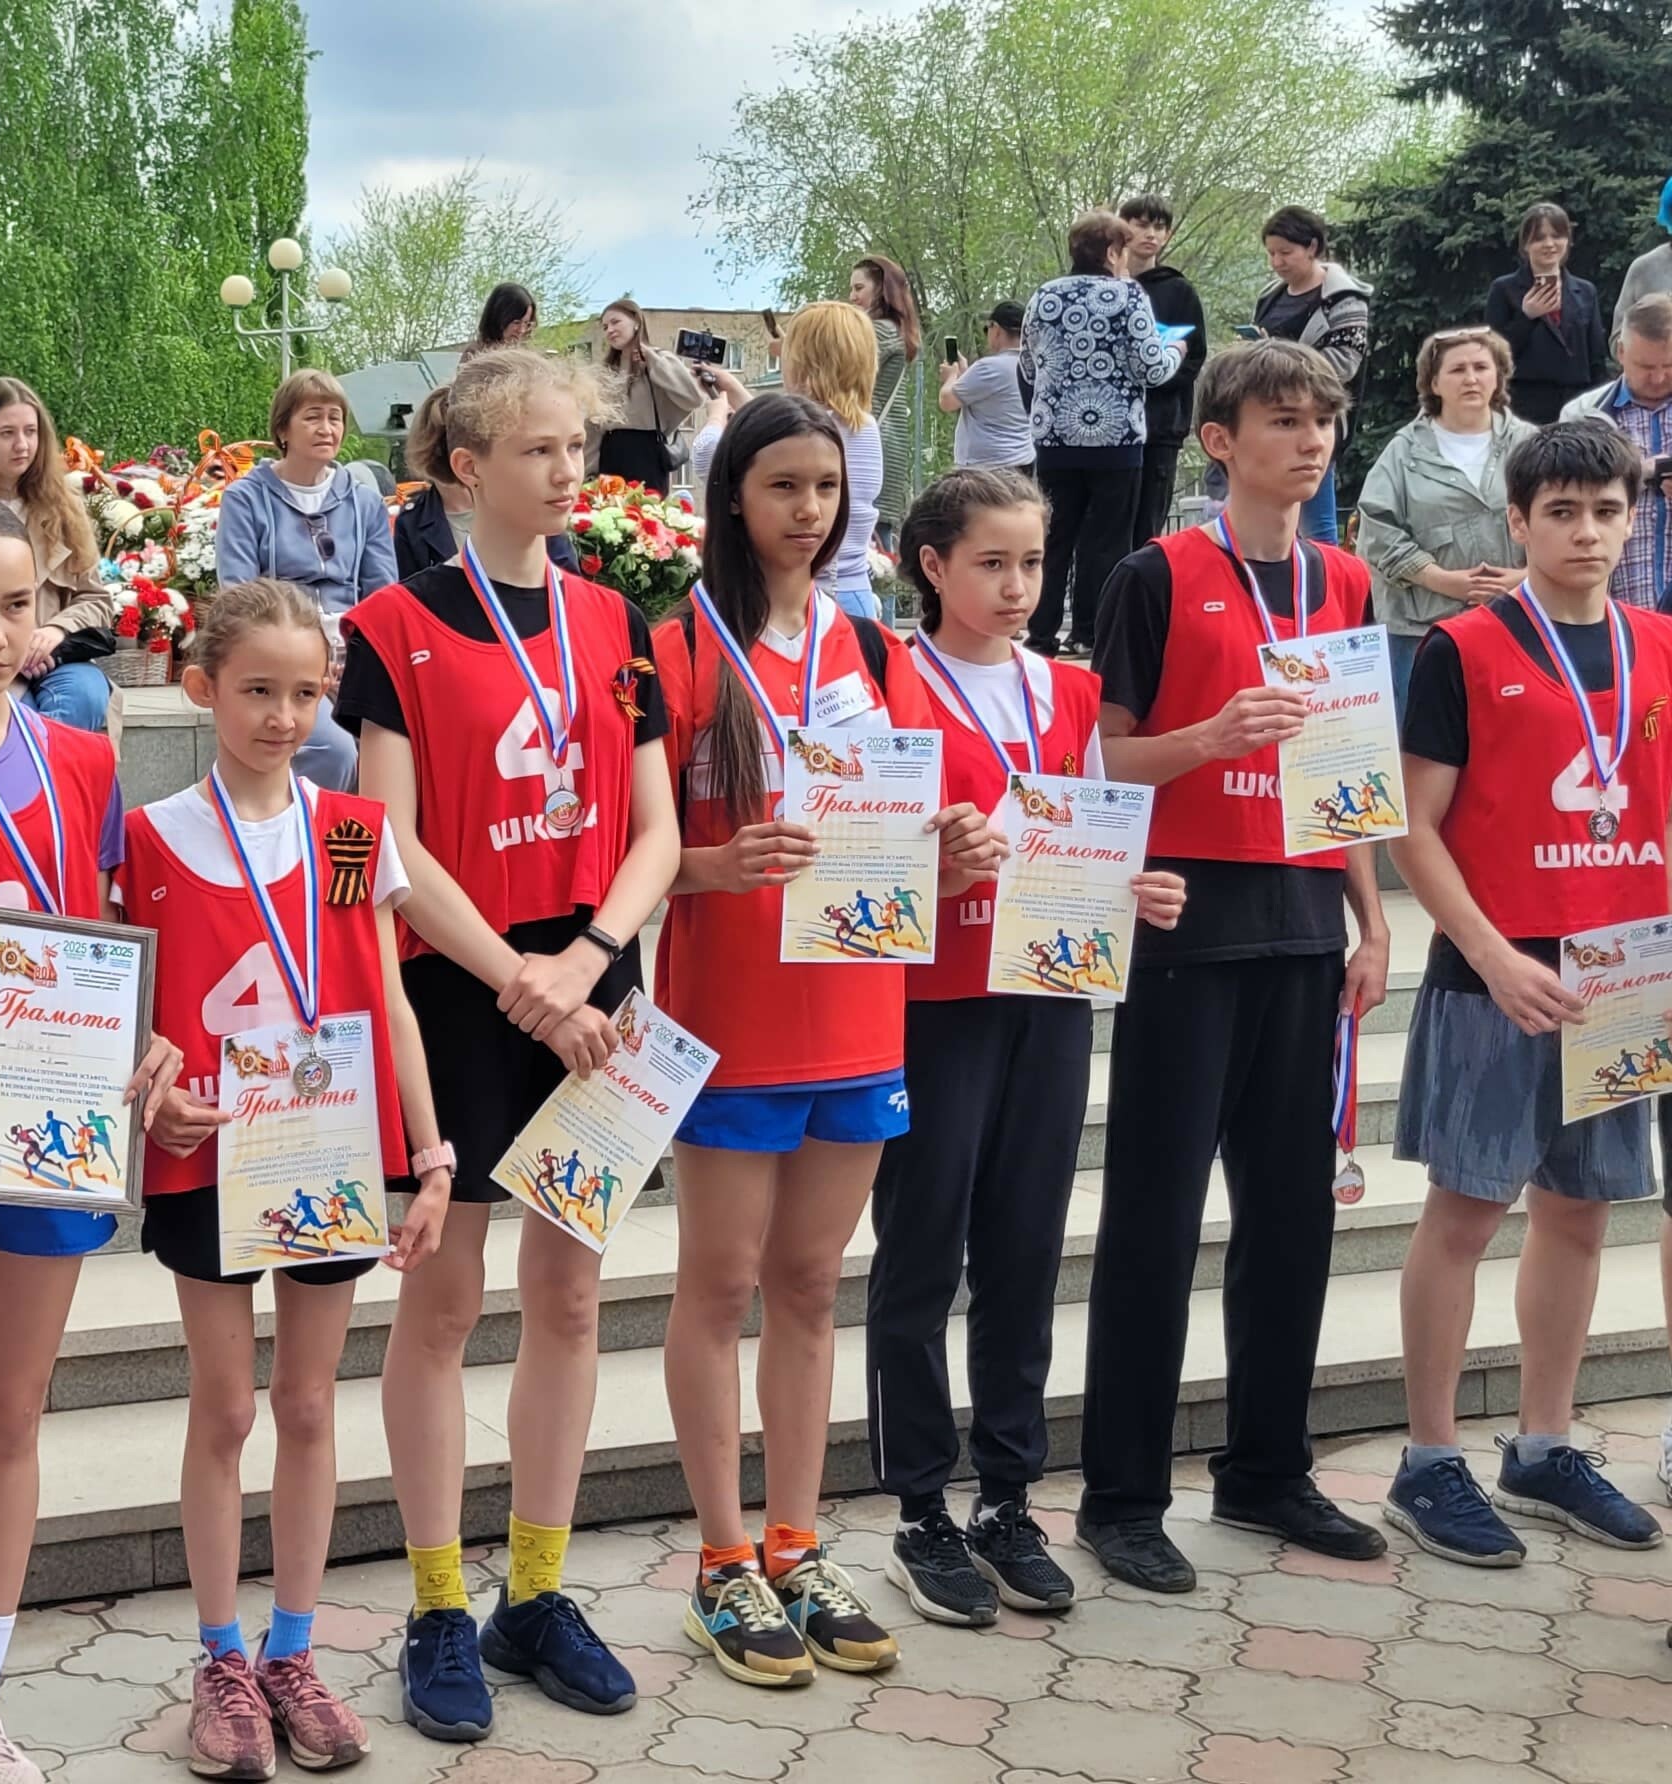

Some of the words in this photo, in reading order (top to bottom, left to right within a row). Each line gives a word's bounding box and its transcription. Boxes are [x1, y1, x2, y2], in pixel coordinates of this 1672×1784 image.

[495, 687, 585, 804] 4
[867, 736, 890, 748] 2025
[911, 737, 935, 747] 2025
[1079, 787, 1101, 799] 2025
[1121, 790, 1145, 801] 2025
[1551, 735, 1629, 829] 4
[801, 784, 926, 823] Грамота
[1015, 828, 1129, 863] Грамота
[1534, 842, 1664, 868] ШКОЛА
[63, 940, 88, 954] 2025
[109, 944, 134, 958] 2025
[232, 1084, 358, 1127] Грамота
[603, 1063, 670, 1115] амота
